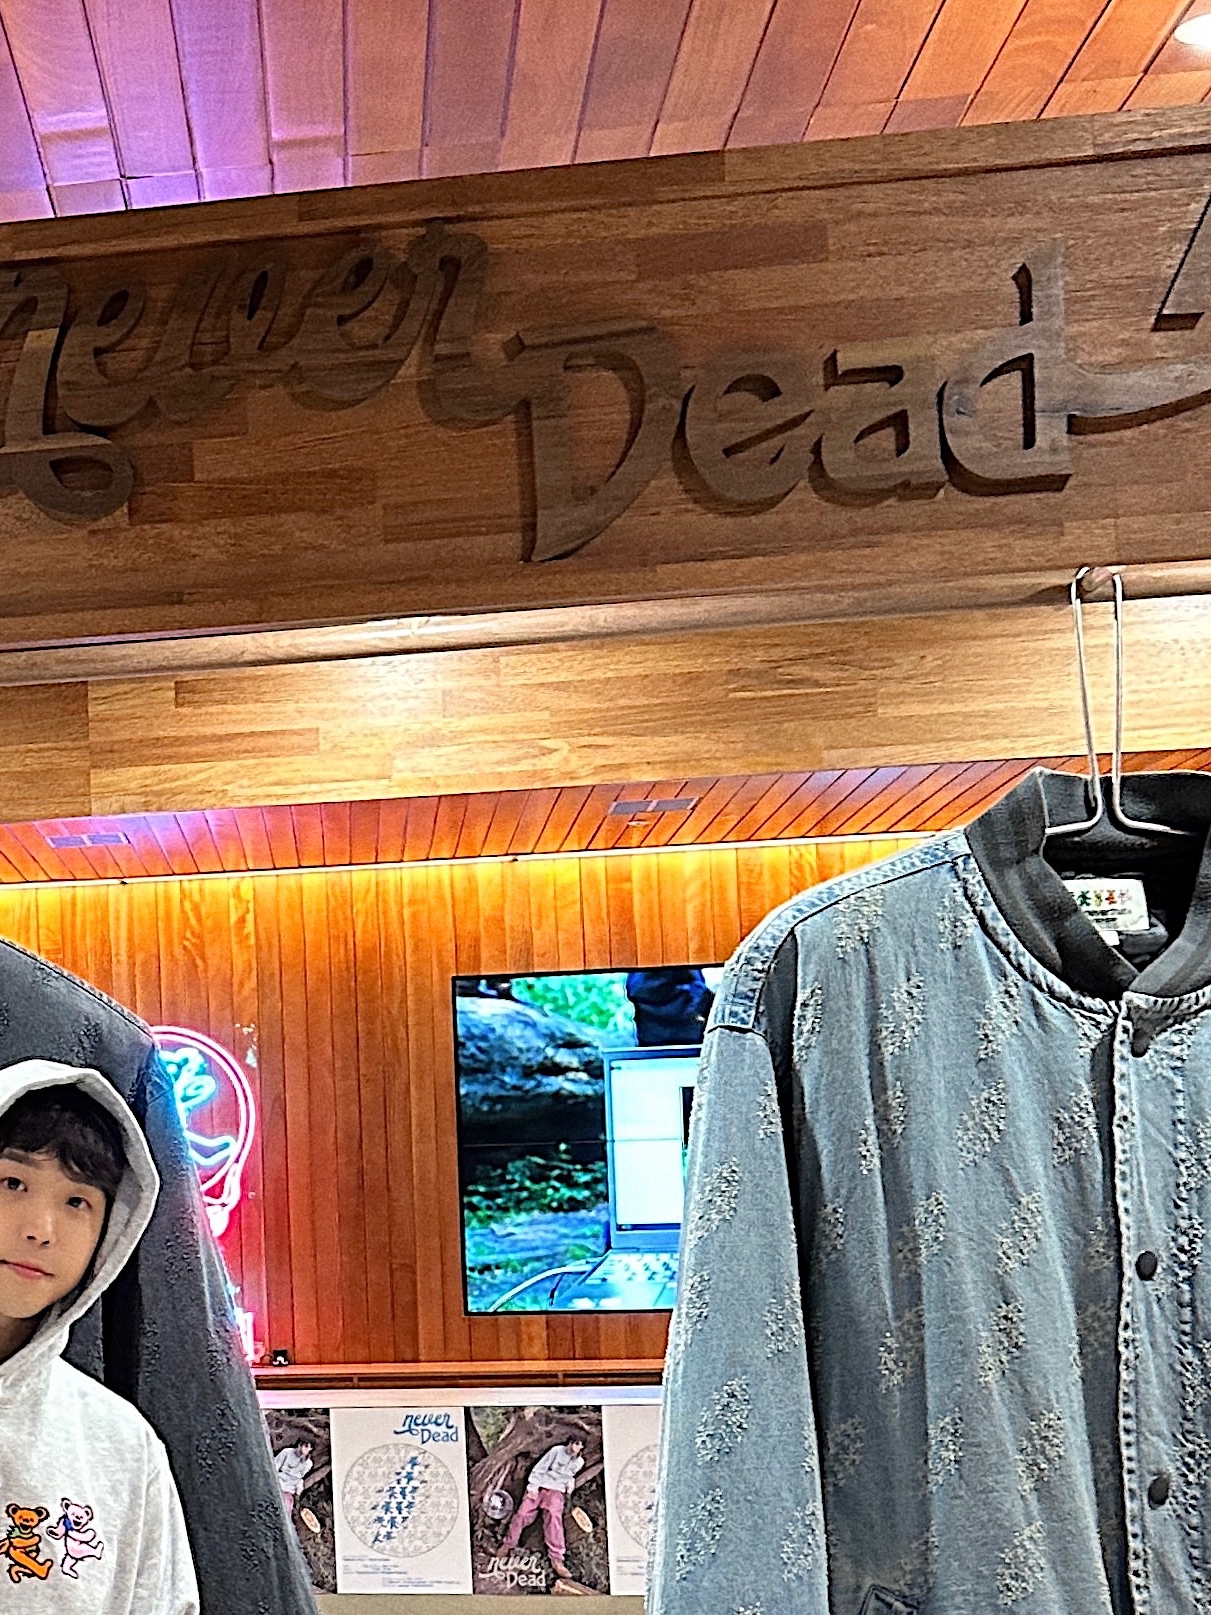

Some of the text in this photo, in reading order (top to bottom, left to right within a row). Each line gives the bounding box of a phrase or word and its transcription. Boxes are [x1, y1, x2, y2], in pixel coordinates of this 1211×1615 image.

[502, 240, 1072, 562] Dead
[393, 1413, 454, 1436] never
[420, 1426, 459, 1445] Dead
[478, 1556, 542, 1580] never
[506, 1569, 547, 1589] Dead
